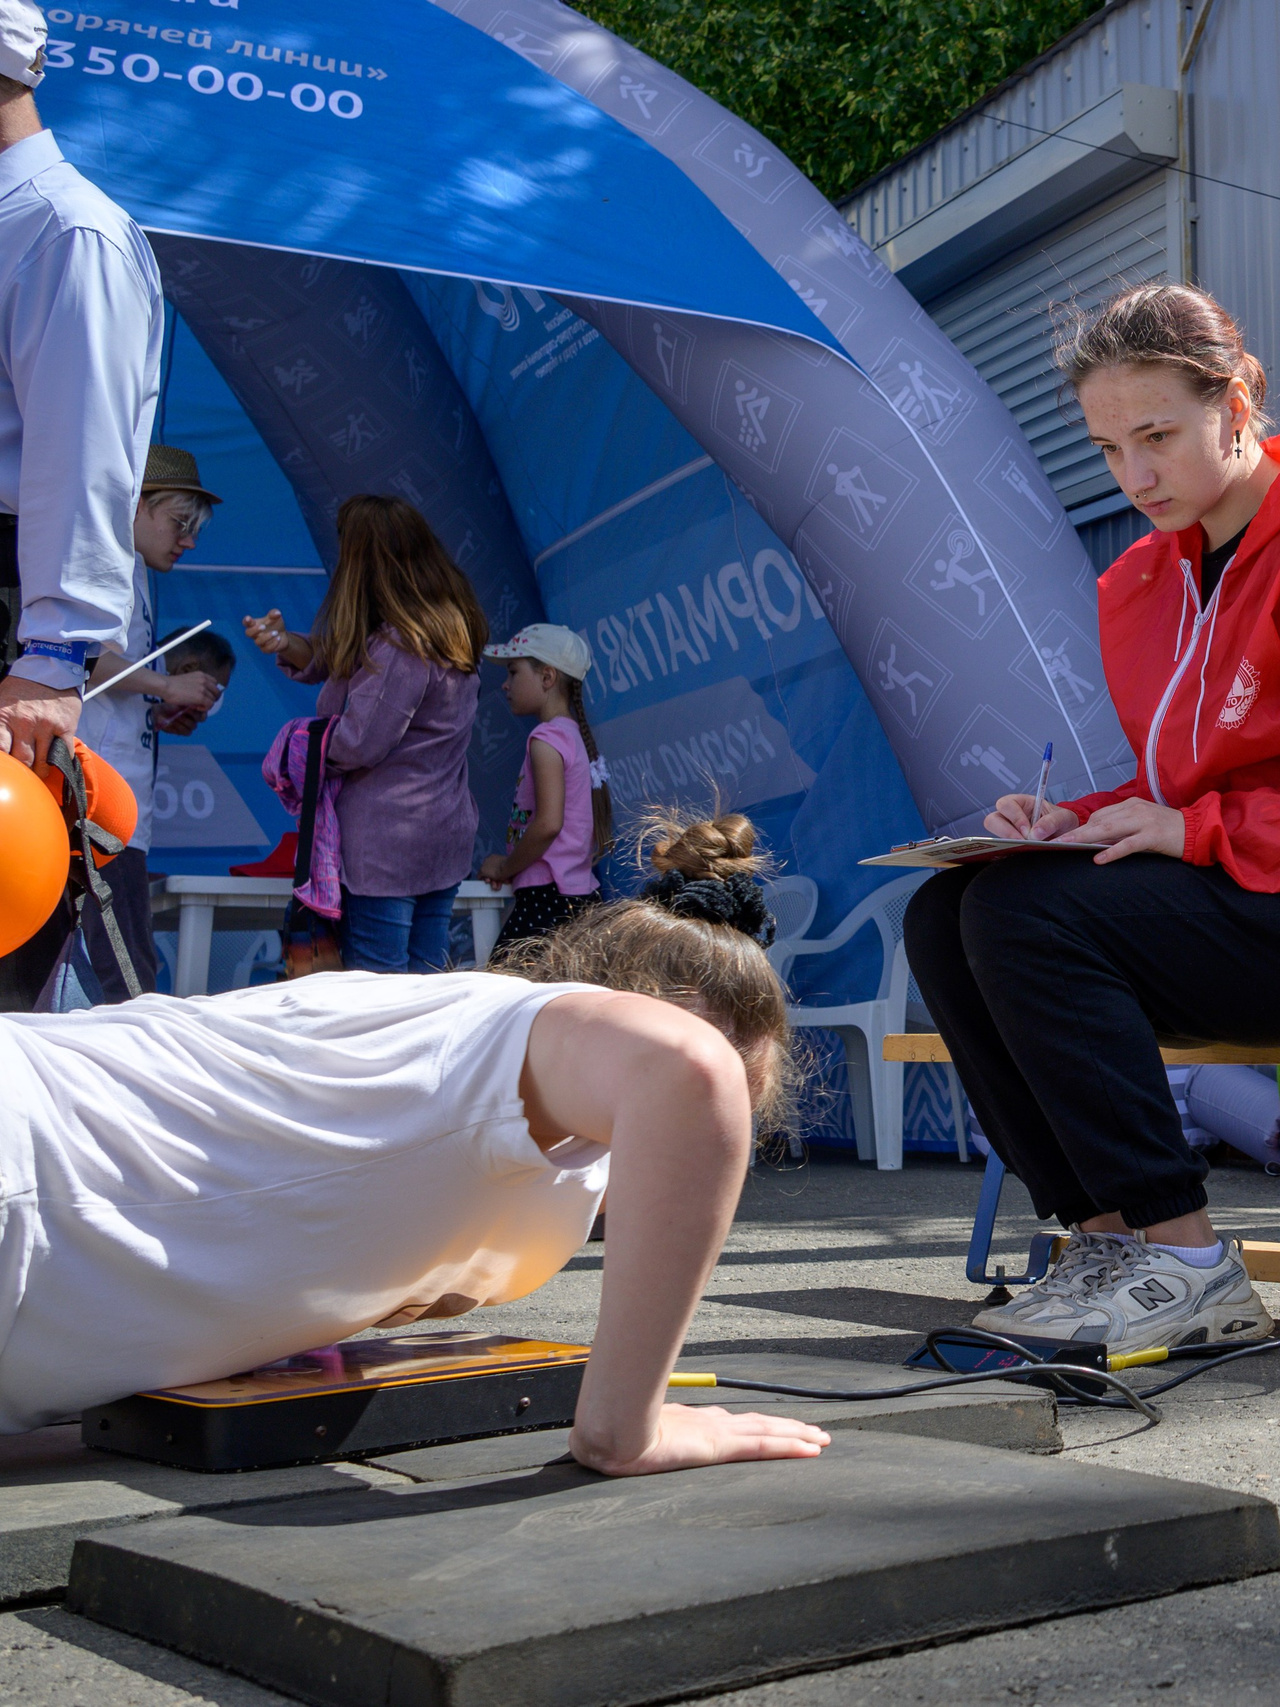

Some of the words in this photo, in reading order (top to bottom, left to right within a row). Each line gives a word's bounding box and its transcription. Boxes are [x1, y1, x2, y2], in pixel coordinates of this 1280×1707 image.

[43, 8, 212, 50] орячей
[226, 39, 388, 81] линии»
[1128, 1277, 1176, 1312] N
